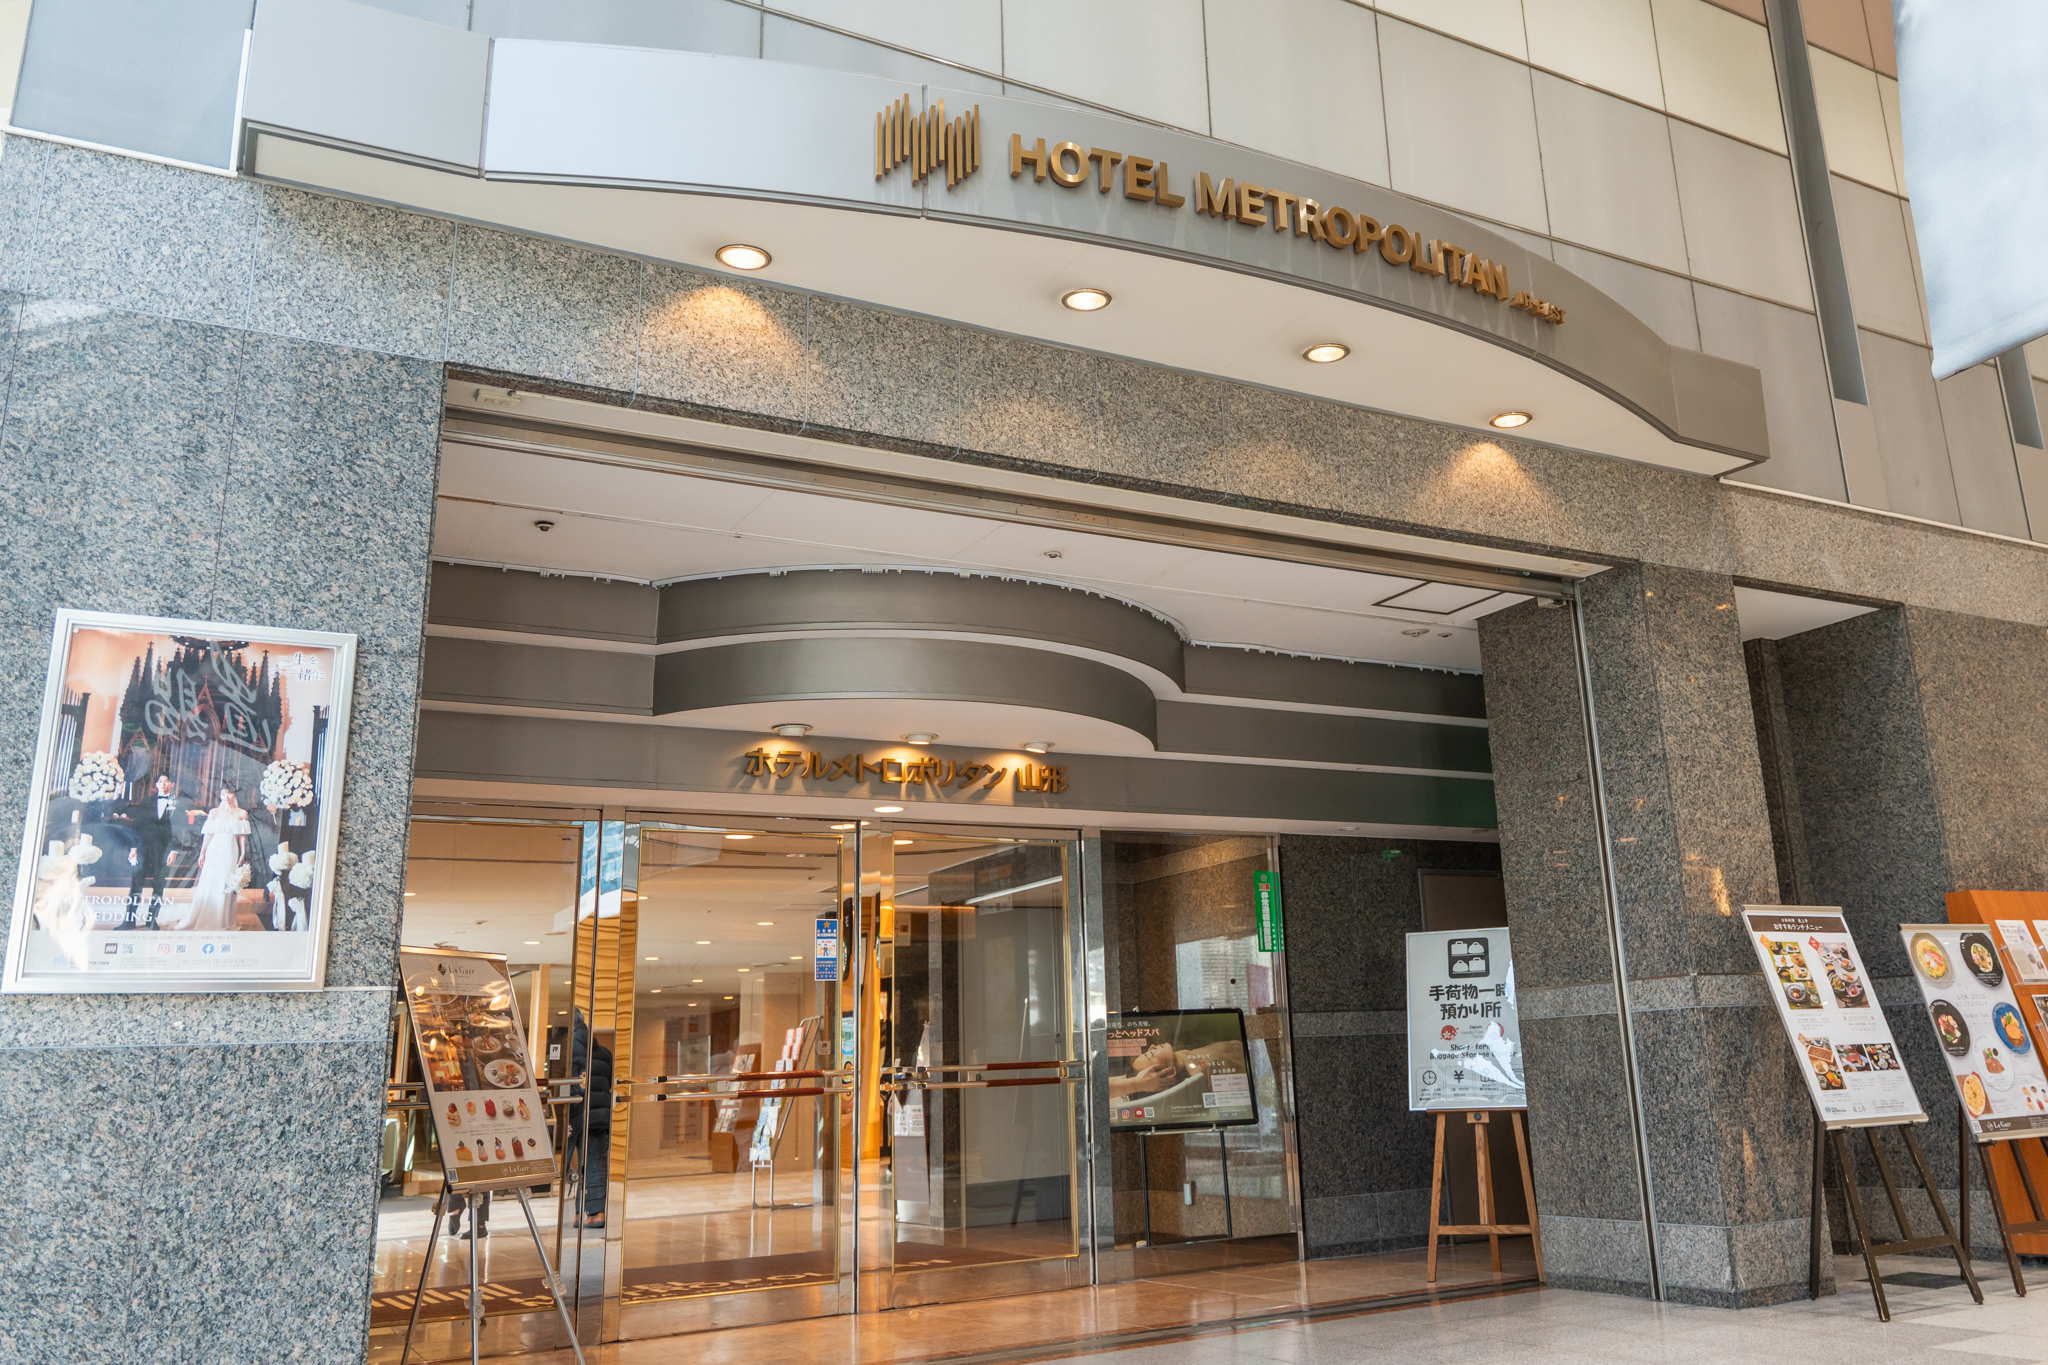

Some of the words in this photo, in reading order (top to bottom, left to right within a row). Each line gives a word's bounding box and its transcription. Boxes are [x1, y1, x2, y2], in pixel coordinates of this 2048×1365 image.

[1009, 132, 1187, 208] HOTEL
[1194, 170, 1510, 302] METROPOLITAN
[744, 747, 1008, 790] ホテルメトロポリタン
[1016, 763, 1071, 794] 山形
[60, 895, 175, 907] MTROPOLITAN
[1773, 923, 1824, 931] おすすめランチメニュー
[1429, 984, 1511, 1001] 手荷物一時
[1440, 1002, 1502, 1020] 預かり所
